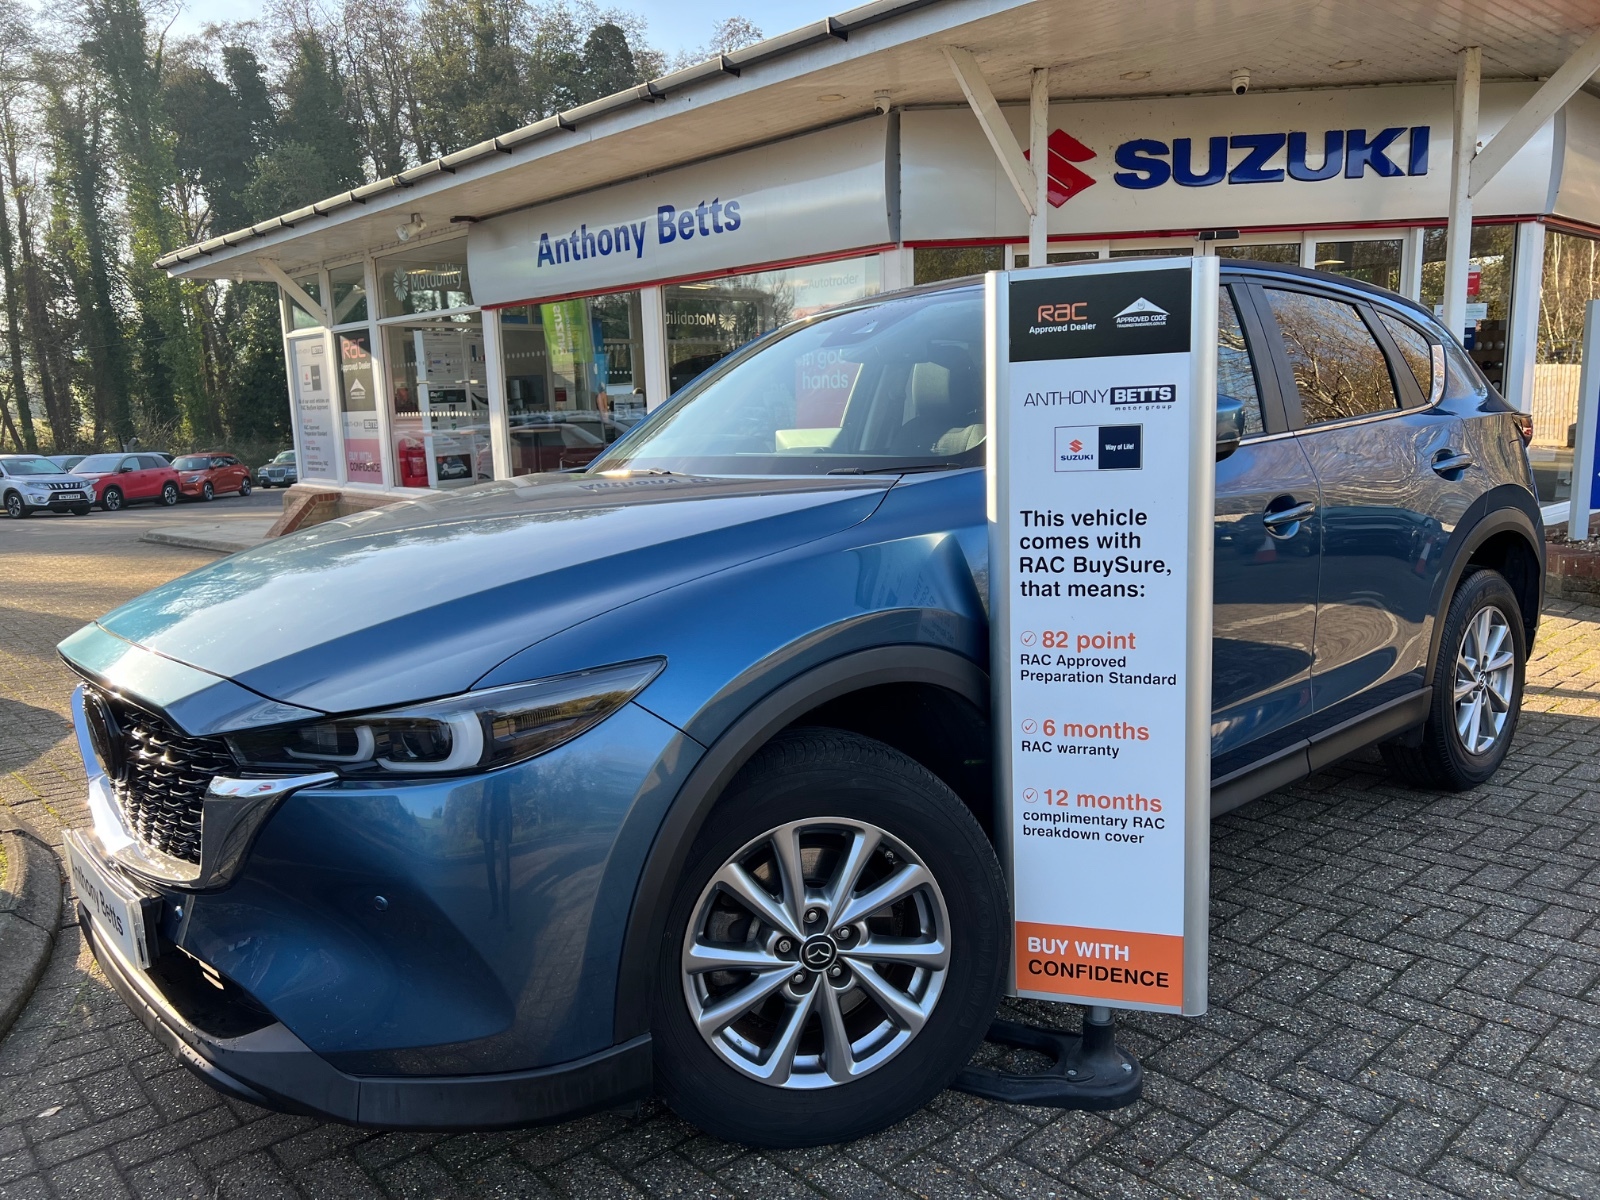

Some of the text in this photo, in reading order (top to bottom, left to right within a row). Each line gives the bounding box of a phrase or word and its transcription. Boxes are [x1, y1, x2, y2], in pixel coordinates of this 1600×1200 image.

[1113, 125, 1431, 190] SUZUKI
[537, 197, 742, 268] Anthony Betts
[411, 262, 463, 292] Motability
[808, 274, 859, 289] Autotrader
[1029, 322, 1097, 335] Approved Dealer
[1116, 314, 1167, 323] APPROVED CODE
[802, 370, 849, 390] hands
[1024, 386, 1173, 407] ANTHONY BETTS
[1105, 443, 1116, 452] Way
[1060, 454, 1094, 462] SUZUKI
[1020, 508, 1148, 528] This vehicle
[1020, 532, 1141, 550] comes with
[1020, 556, 1172, 577] RAC BuySure,
[1020, 580, 1145, 598] that means:
[1042, 630, 1136, 653] 82 point
[1020, 654, 1126, 670] RAC Approved
[1021, 669, 1177, 686] Preparation Standard
[1043, 719, 1150, 741] 6 months
[1021, 740, 1120, 759] RAC warranty
[1044, 789, 1163, 813] 12 months
[1023, 811, 1166, 830] complimentary RAC
[1023, 825, 1145, 844] breakdown cover
[99, 891, 124, 937] Betts
[1027, 936, 1130, 962] BUY WITH
[1028, 959, 1170, 989] CONFIDENCE
